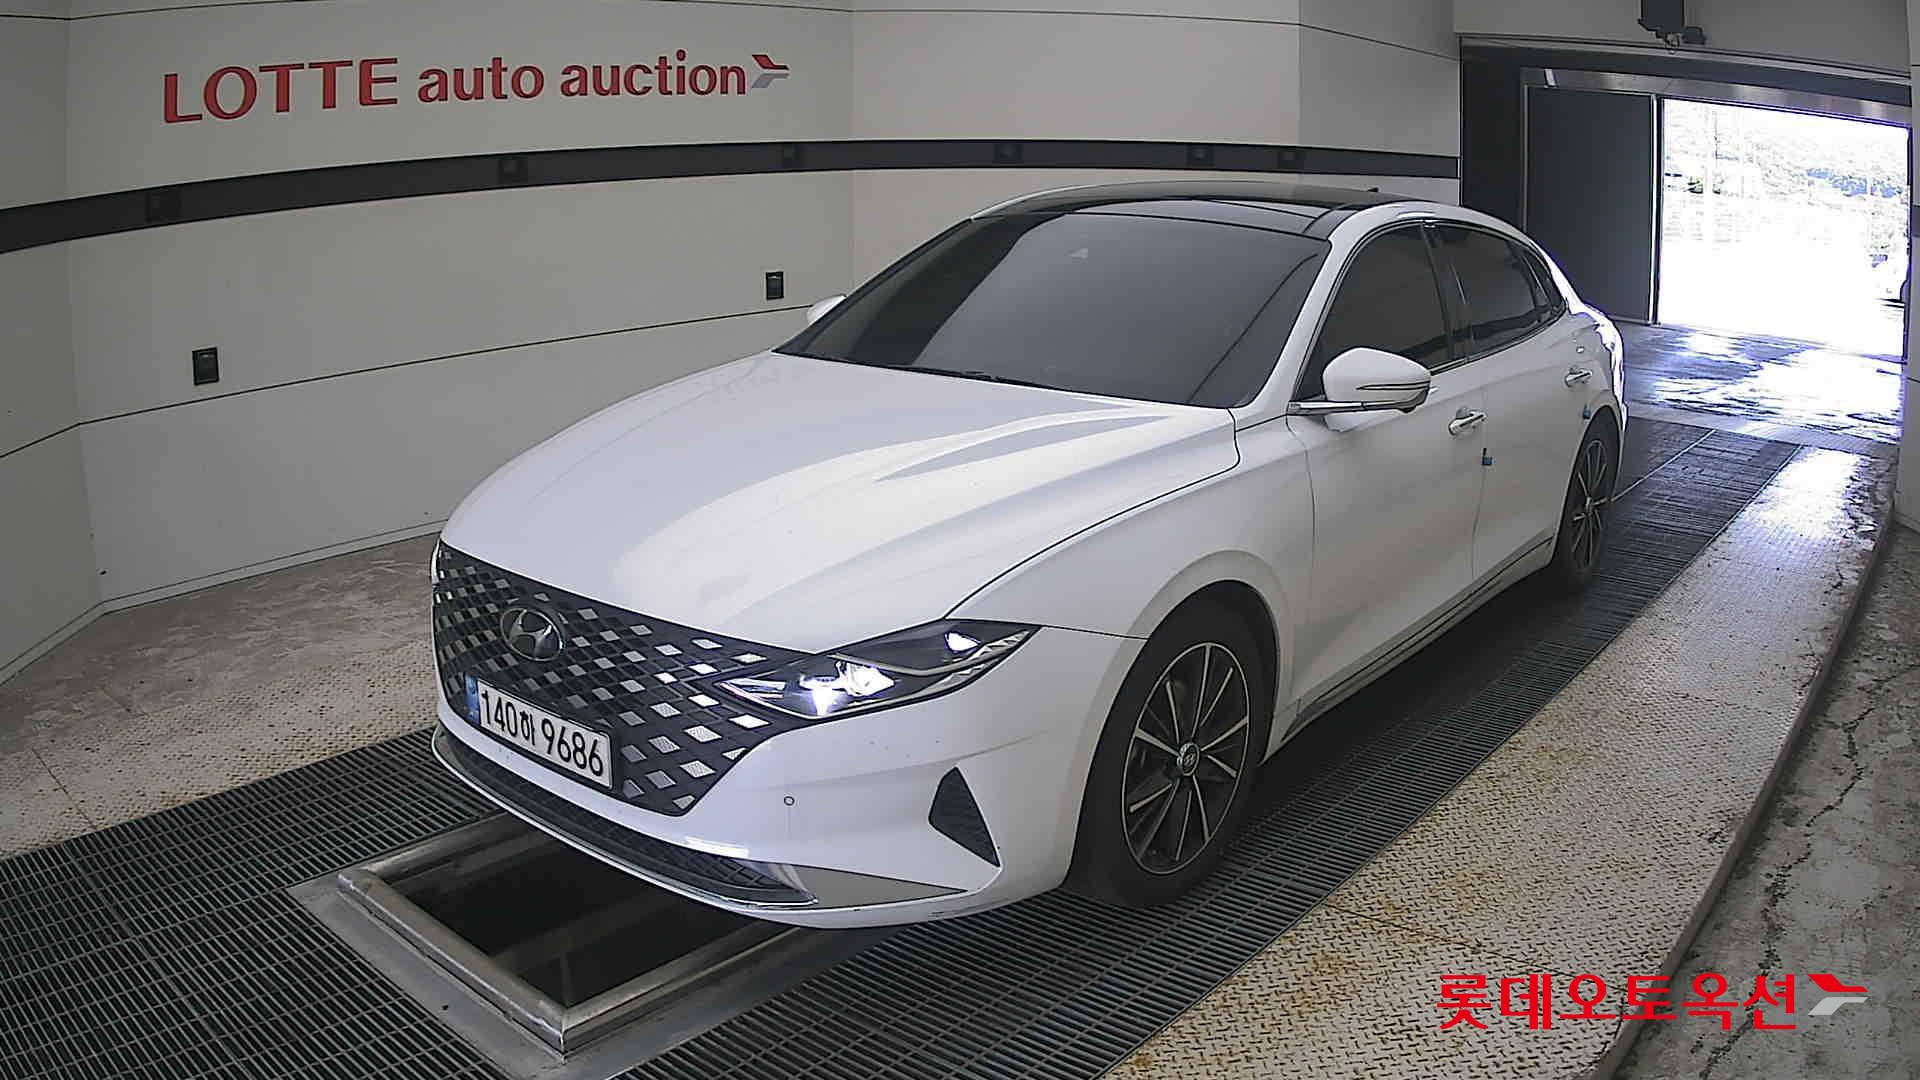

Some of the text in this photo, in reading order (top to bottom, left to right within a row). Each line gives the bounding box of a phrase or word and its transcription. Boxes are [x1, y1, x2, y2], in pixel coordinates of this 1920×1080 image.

[163, 49, 748, 124] LOTTE auto auction
[481, 690, 604, 777] 140하 9686
